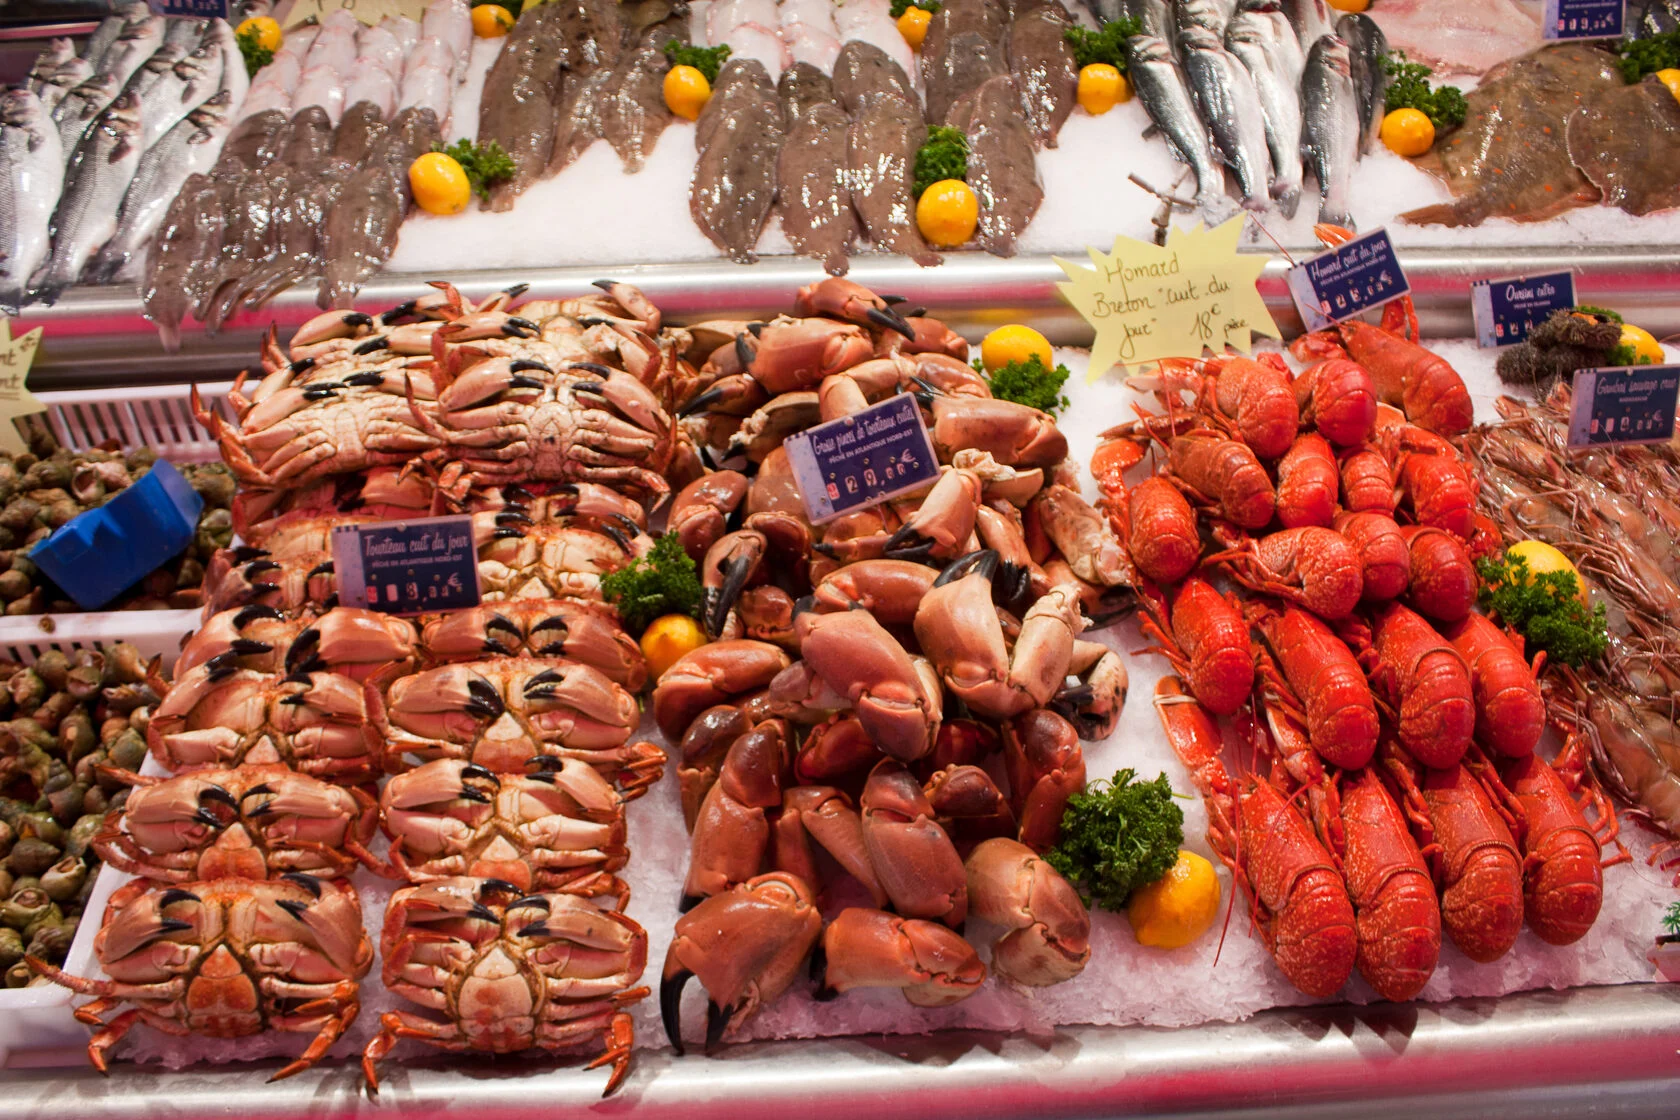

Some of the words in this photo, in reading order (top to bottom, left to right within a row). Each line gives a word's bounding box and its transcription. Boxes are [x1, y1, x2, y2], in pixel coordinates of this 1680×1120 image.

[1311, 256, 1341, 281] Homard
[1343, 248, 1358, 268] cuit
[1360, 243, 1371, 259] du
[1370, 239, 1387, 257] jour
[1104, 252, 1180, 303] Homard
[1093, 292, 1154, 318] Breton
[857, 422, 865, 440] de
[902, 448, 916, 463] €
[364, 535, 406, 556] Tourteau
[409, 533, 431, 553] cuit
[432, 531, 445, 551] du
[444, 535, 468, 555] jour
